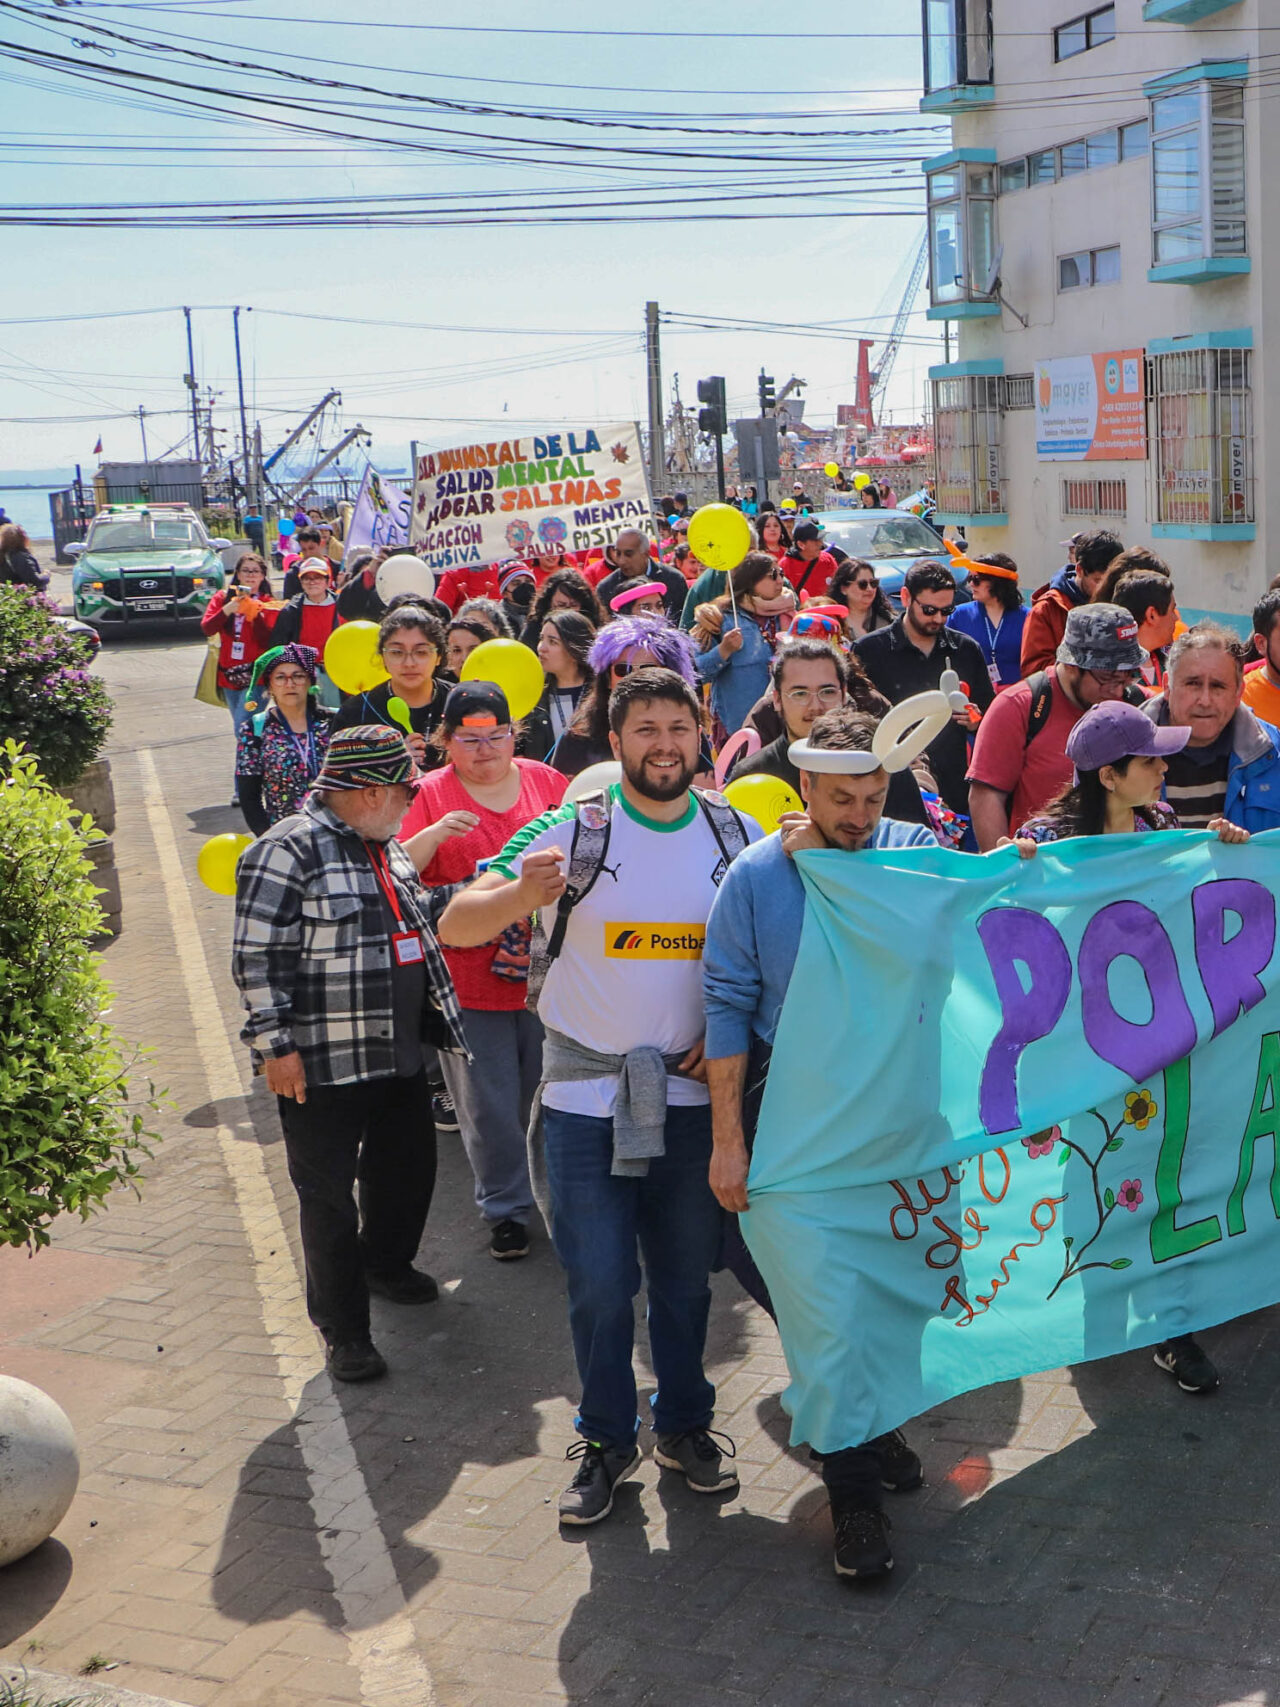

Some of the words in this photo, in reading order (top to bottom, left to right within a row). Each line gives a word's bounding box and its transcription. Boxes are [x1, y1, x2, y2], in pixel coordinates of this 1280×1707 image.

[1052, 380, 1091, 404] mayer
[418, 454, 436, 481] DIA
[437, 440, 528, 475] MUNDIAL
[533, 434, 563, 460] DE
[567, 429, 602, 456] LA
[989, 450, 999, 489] mayer
[1233, 442, 1243, 492] mayer
[436, 469, 494, 499] SALUD
[496, 456, 595, 489] MENTAL
[426, 493, 496, 531] HOGAR
[500, 478, 622, 512] SALINAS
[573, 499, 650, 527] MENTAL
[513, 541, 567, 560] SALUD
[650, 933, 706, 950] Postba
[976, 878, 1276, 1136] POR
[925, 1207, 990, 1269] de
